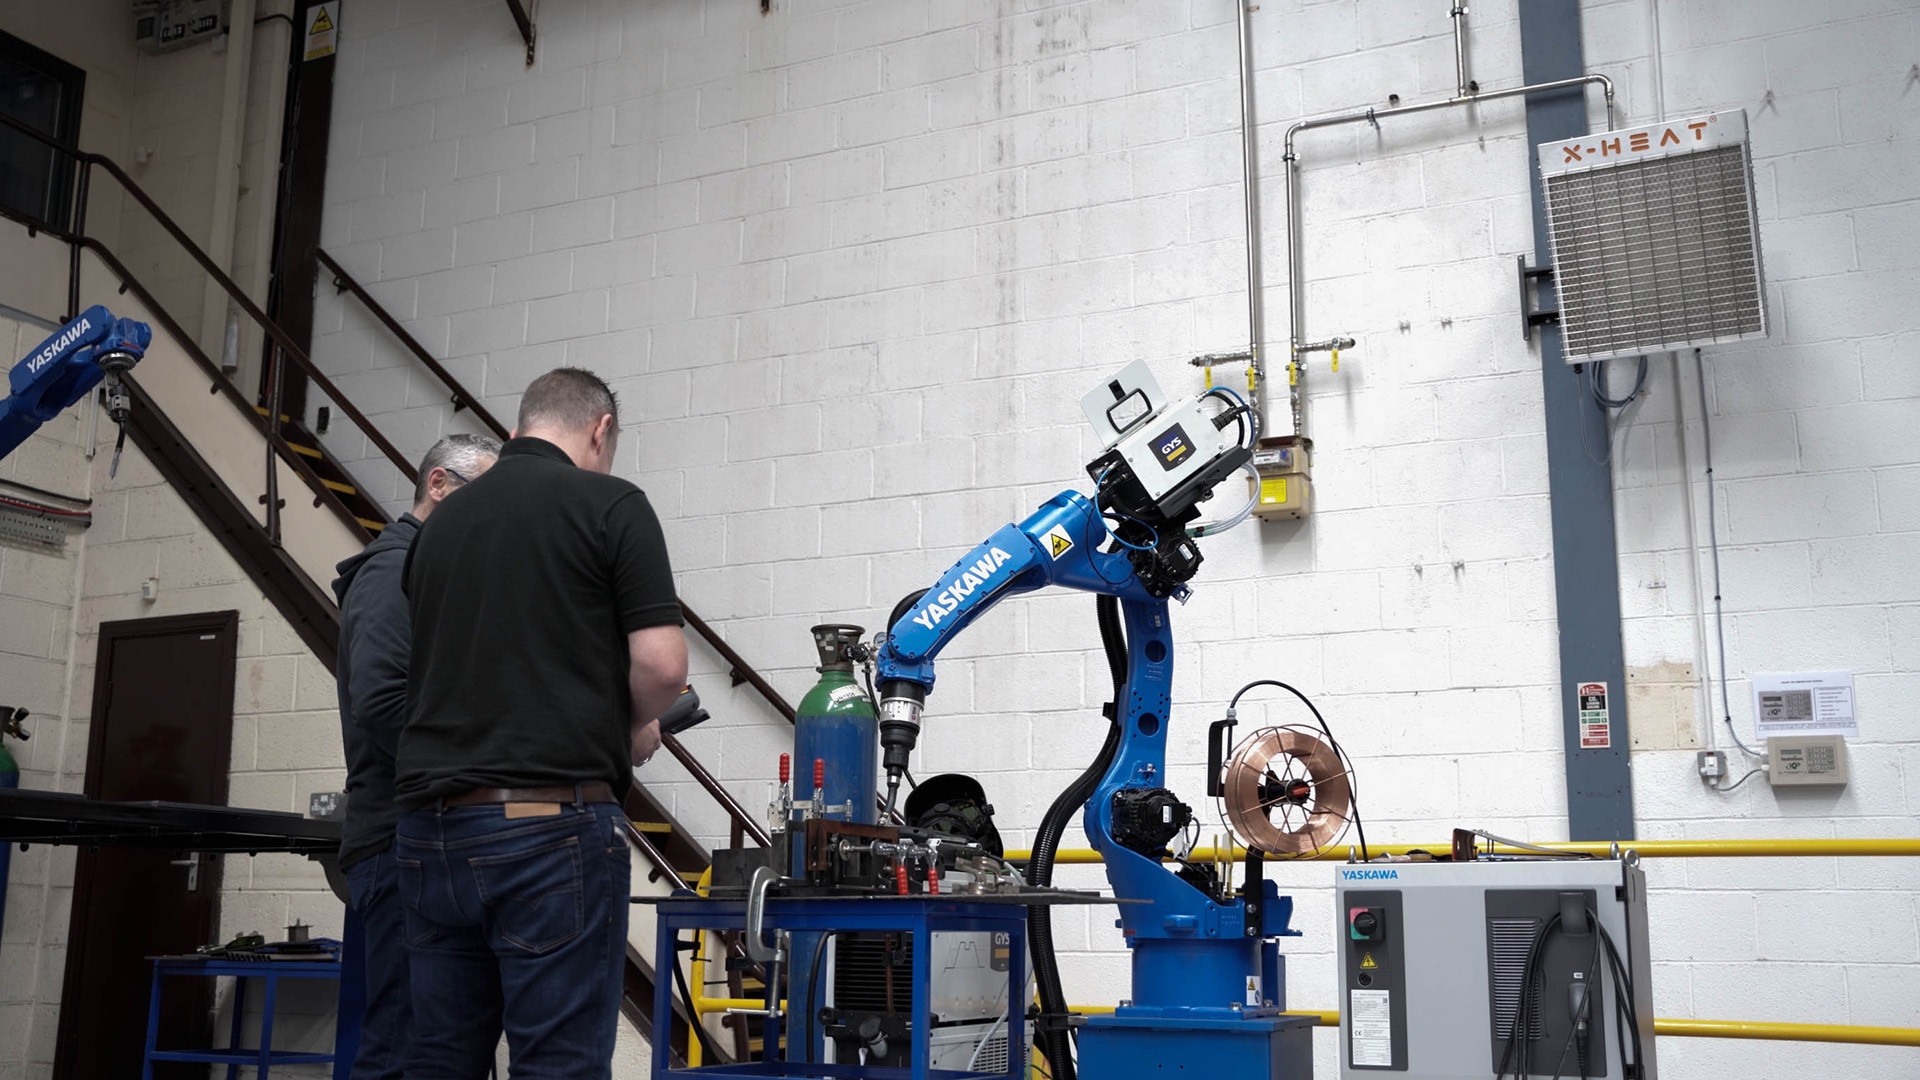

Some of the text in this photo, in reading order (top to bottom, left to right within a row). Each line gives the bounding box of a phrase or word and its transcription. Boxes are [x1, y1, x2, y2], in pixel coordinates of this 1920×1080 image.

[1563, 121, 1707, 163] X-HEAT
[26, 318, 91, 373] YASKAWA
[1161, 436, 1182, 455] GYS
[912, 547, 1012, 630] YASKAWA
[1342, 870, 1398, 880] YASKAWA
[995, 932, 1010, 945] GYS
